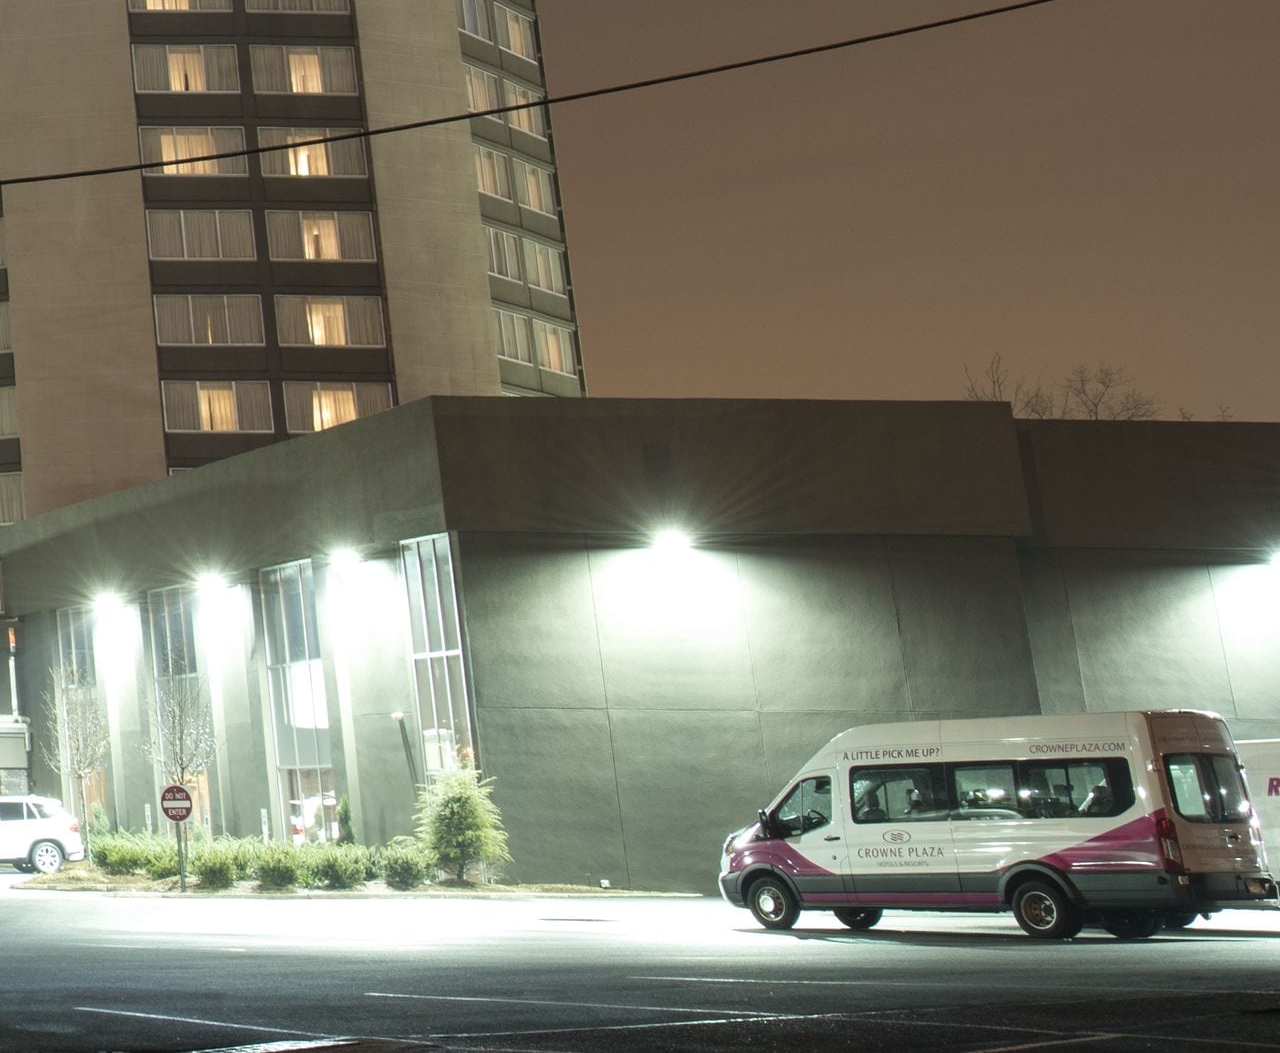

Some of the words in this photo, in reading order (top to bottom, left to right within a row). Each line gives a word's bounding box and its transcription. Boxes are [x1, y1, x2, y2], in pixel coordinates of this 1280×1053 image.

[1029, 742, 1125, 754] CROWNEPLAZA.COM
[843, 752, 849, 761] A
[851, 751, 880, 761] LITTLE
[882, 749, 903, 759] PICK
[906, 748, 920, 758] ME
[922, 747, 940, 757] UP?
[168, 808, 186, 816] ENTER
[858, 847, 903, 858] CROWNE
[908, 847, 944, 857] PLAZA
